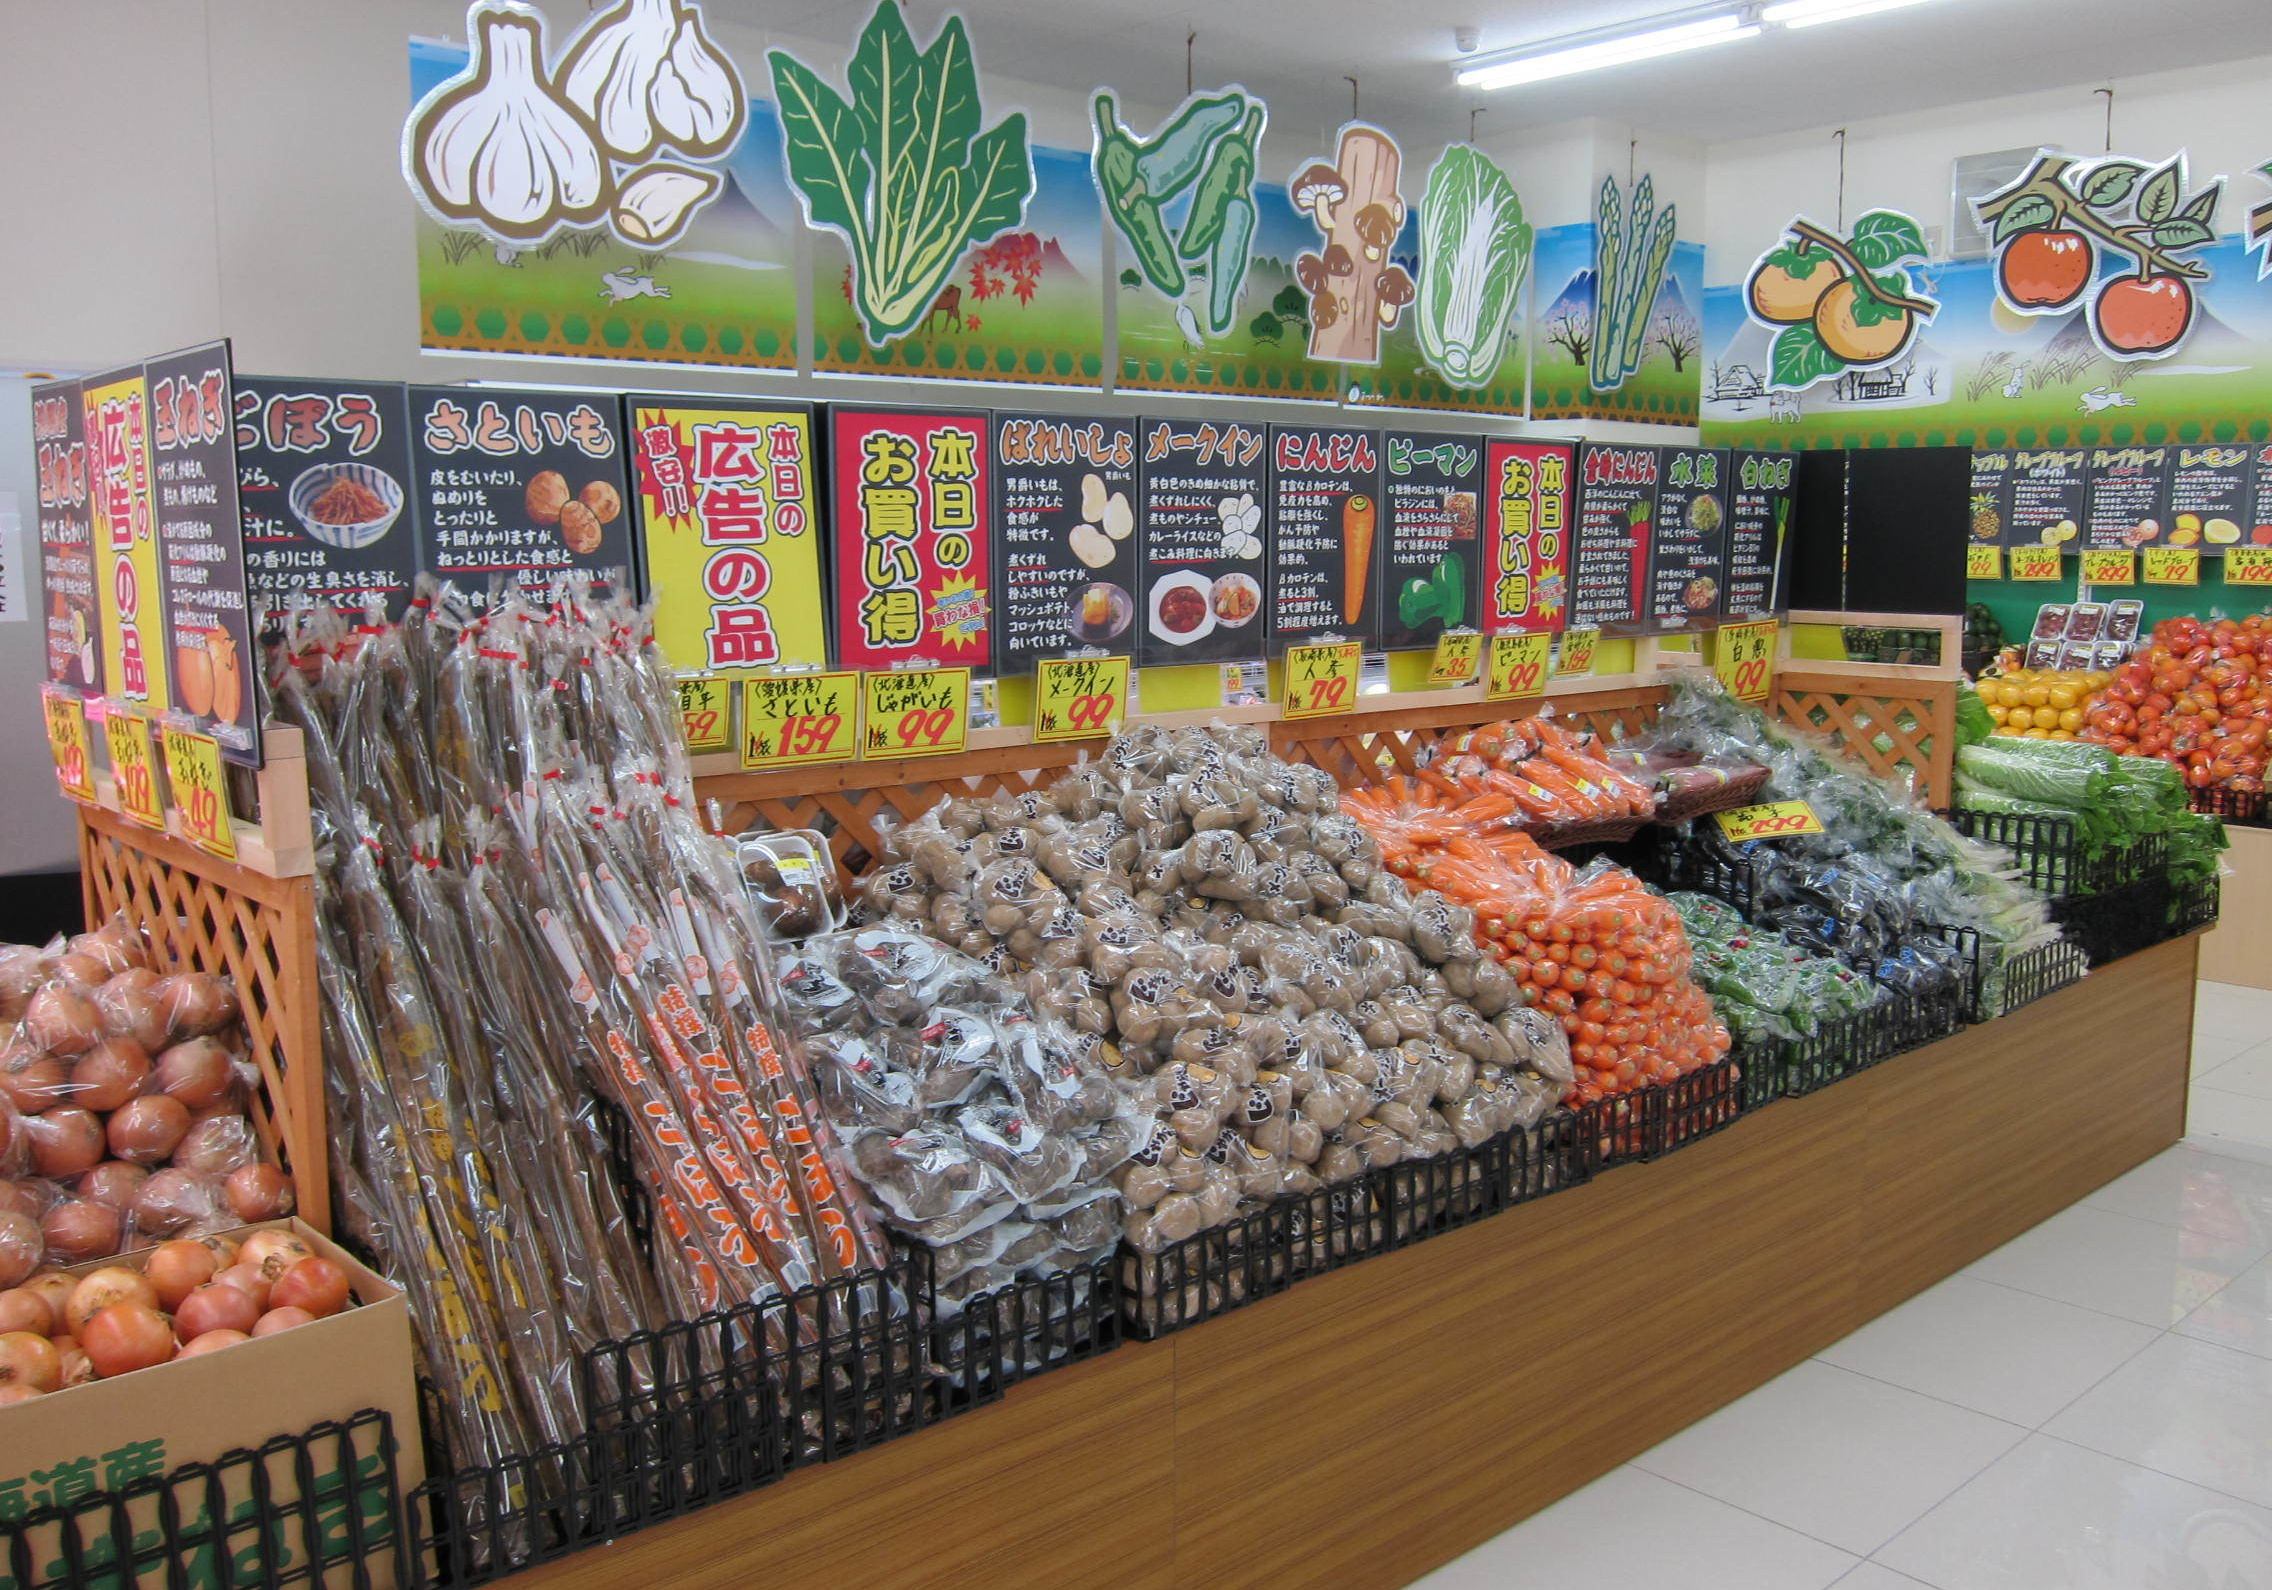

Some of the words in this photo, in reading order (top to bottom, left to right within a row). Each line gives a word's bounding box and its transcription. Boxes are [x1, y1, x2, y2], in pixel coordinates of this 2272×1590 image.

[154, 368, 225, 450] 玉ねぎ
[424, 398, 615, 459] さといも
[1145, 422, 1262, 466] メークイン
[1276, 432, 1376, 474] にんじん
[1388, 437, 1477, 477] ピーマン
[2180, 447, 2247, 468] レモン
[128, 391, 150, 541] 本日の
[431, 469, 522, 486] 皮をむいたり、
[766, 422, 807, 536] 本日の
[1669, 452, 1718, 489] 水菜
[1740, 455, 1792, 490] 白ねぎ
[432, 490, 487, 506] ぬめりを
[926, 428, 979, 569] 本日の
[1006, 495, 1063, 508] ホクホクした
[1536, 453, 1566, 560] 本日の
[434, 510, 498, 526] とったりと
[1006, 511, 1039, 525] 食感が
[1278, 524, 1320, 536] がん予防や
[102, 397, 148, 699] 広告の品
[436, 530, 558, 547] 手間かかりますが、
[693, 421, 779, 669] 広告の品
[860, 428, 923, 649] お買い得
[1006, 528, 1054, 542] 特徴です。
[1148, 530, 1221, 543] カレーライスなどの
[1495, 456, 1534, 617] お買い得
[437, 549, 573, 566] ねっとりとした食感と
[1008, 553, 1047, 567] 煮くずれ
[2097, 565, 2130, 580] 299
[1008, 586, 1068, 600] 粉ふきいもや
[1008, 618, 1073, 633] コロッケなどに
[1009, 634, 1072, 650] 向いています。
[1050, 676, 1115, 698] メークイン
[1508, 662, 1540, 692] 99
[1735, 659, 1766, 696] 99
[762, 692, 838, 718] さといも
[877, 687, 952, 714] じゃがいも
[1309, 676, 1347, 709] 79
[1068, 694, 1115, 731] 99
[776, 713, 841, 757] 159
[897, 708, 955, 748] 99
[1750, 814, 1809, 834] 299
